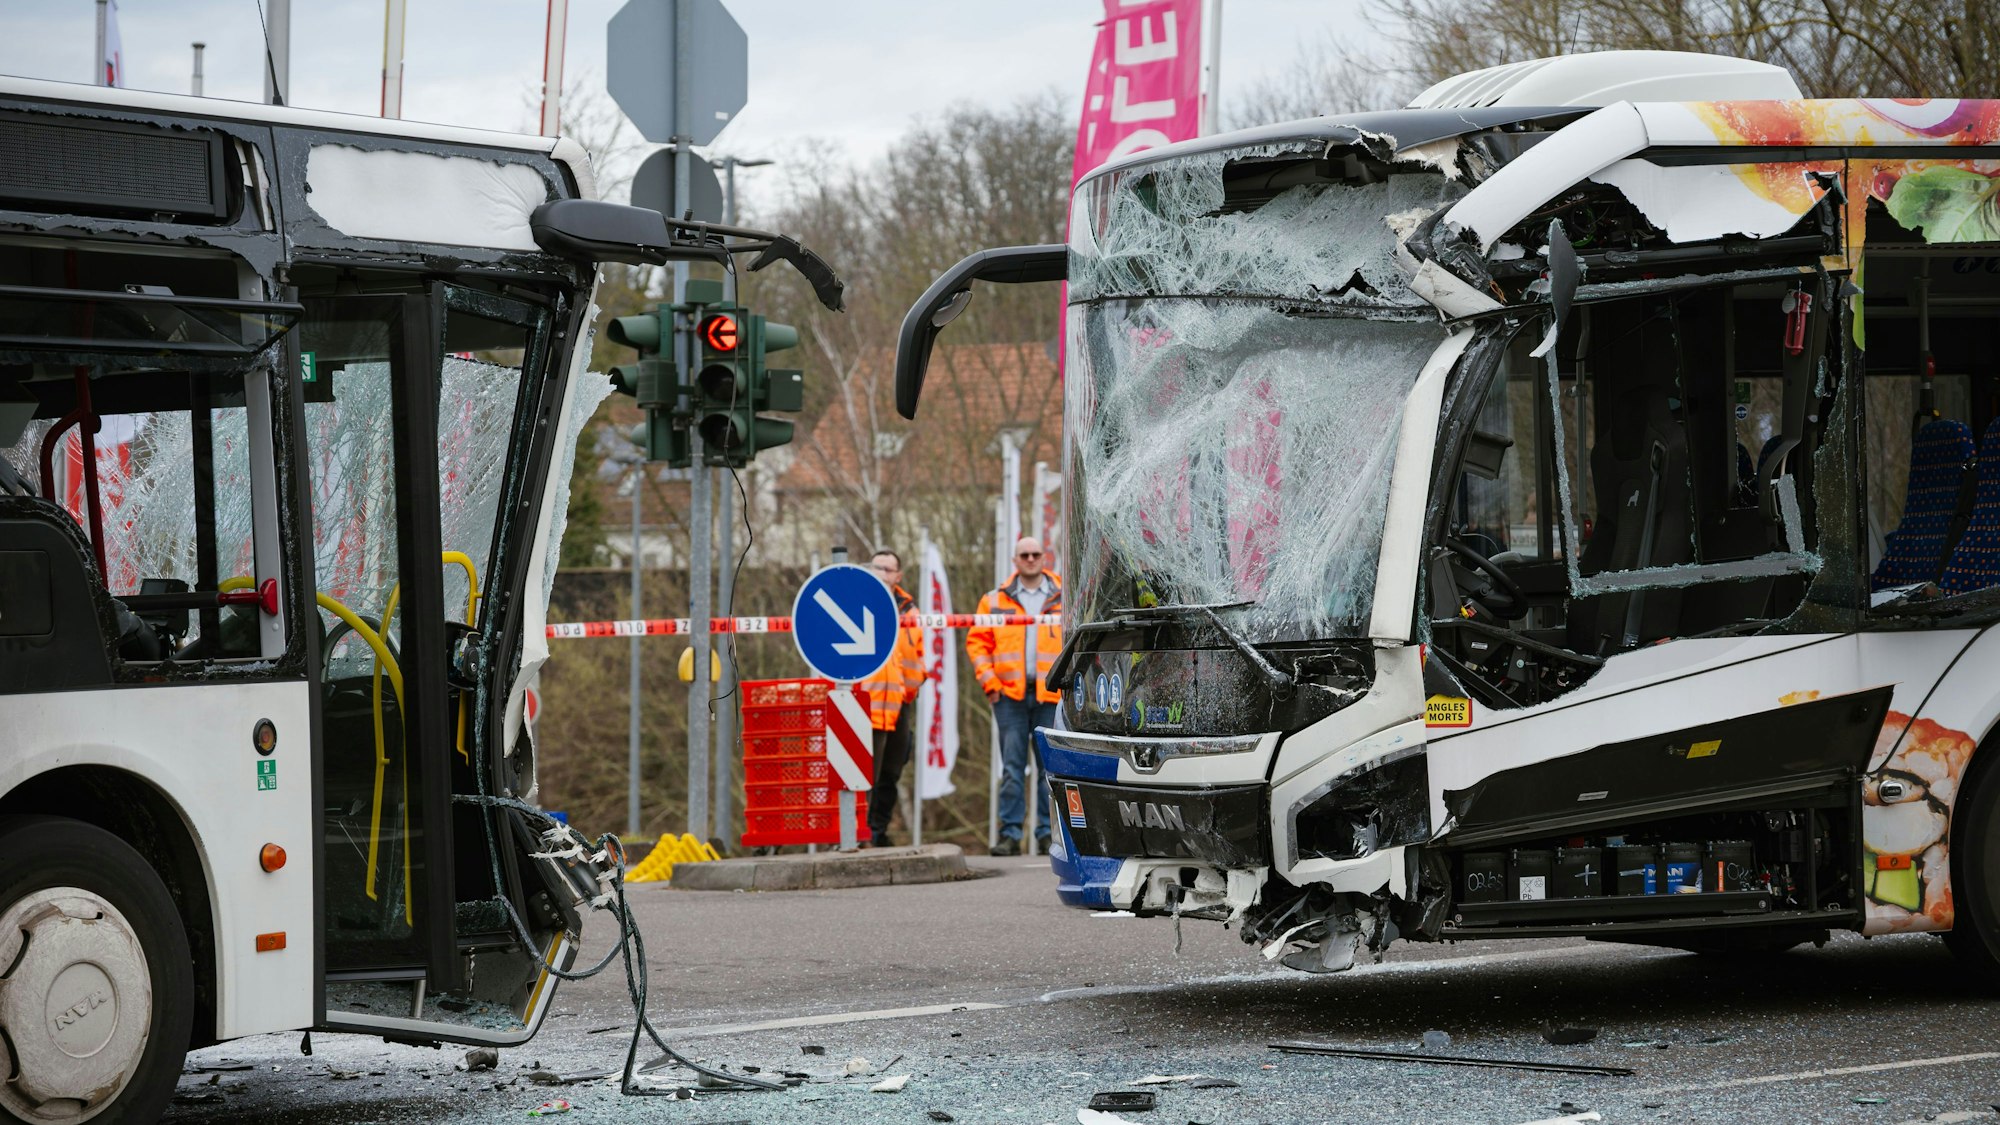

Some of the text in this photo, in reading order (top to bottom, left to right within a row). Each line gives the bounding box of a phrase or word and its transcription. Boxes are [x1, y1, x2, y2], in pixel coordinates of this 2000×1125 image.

[590, 621, 655, 635] POLIZEI
[1427, 703, 1465, 711] ANGLES
[1429, 713, 1464, 721] MORTS
[1118, 801, 1186, 832] MAN
